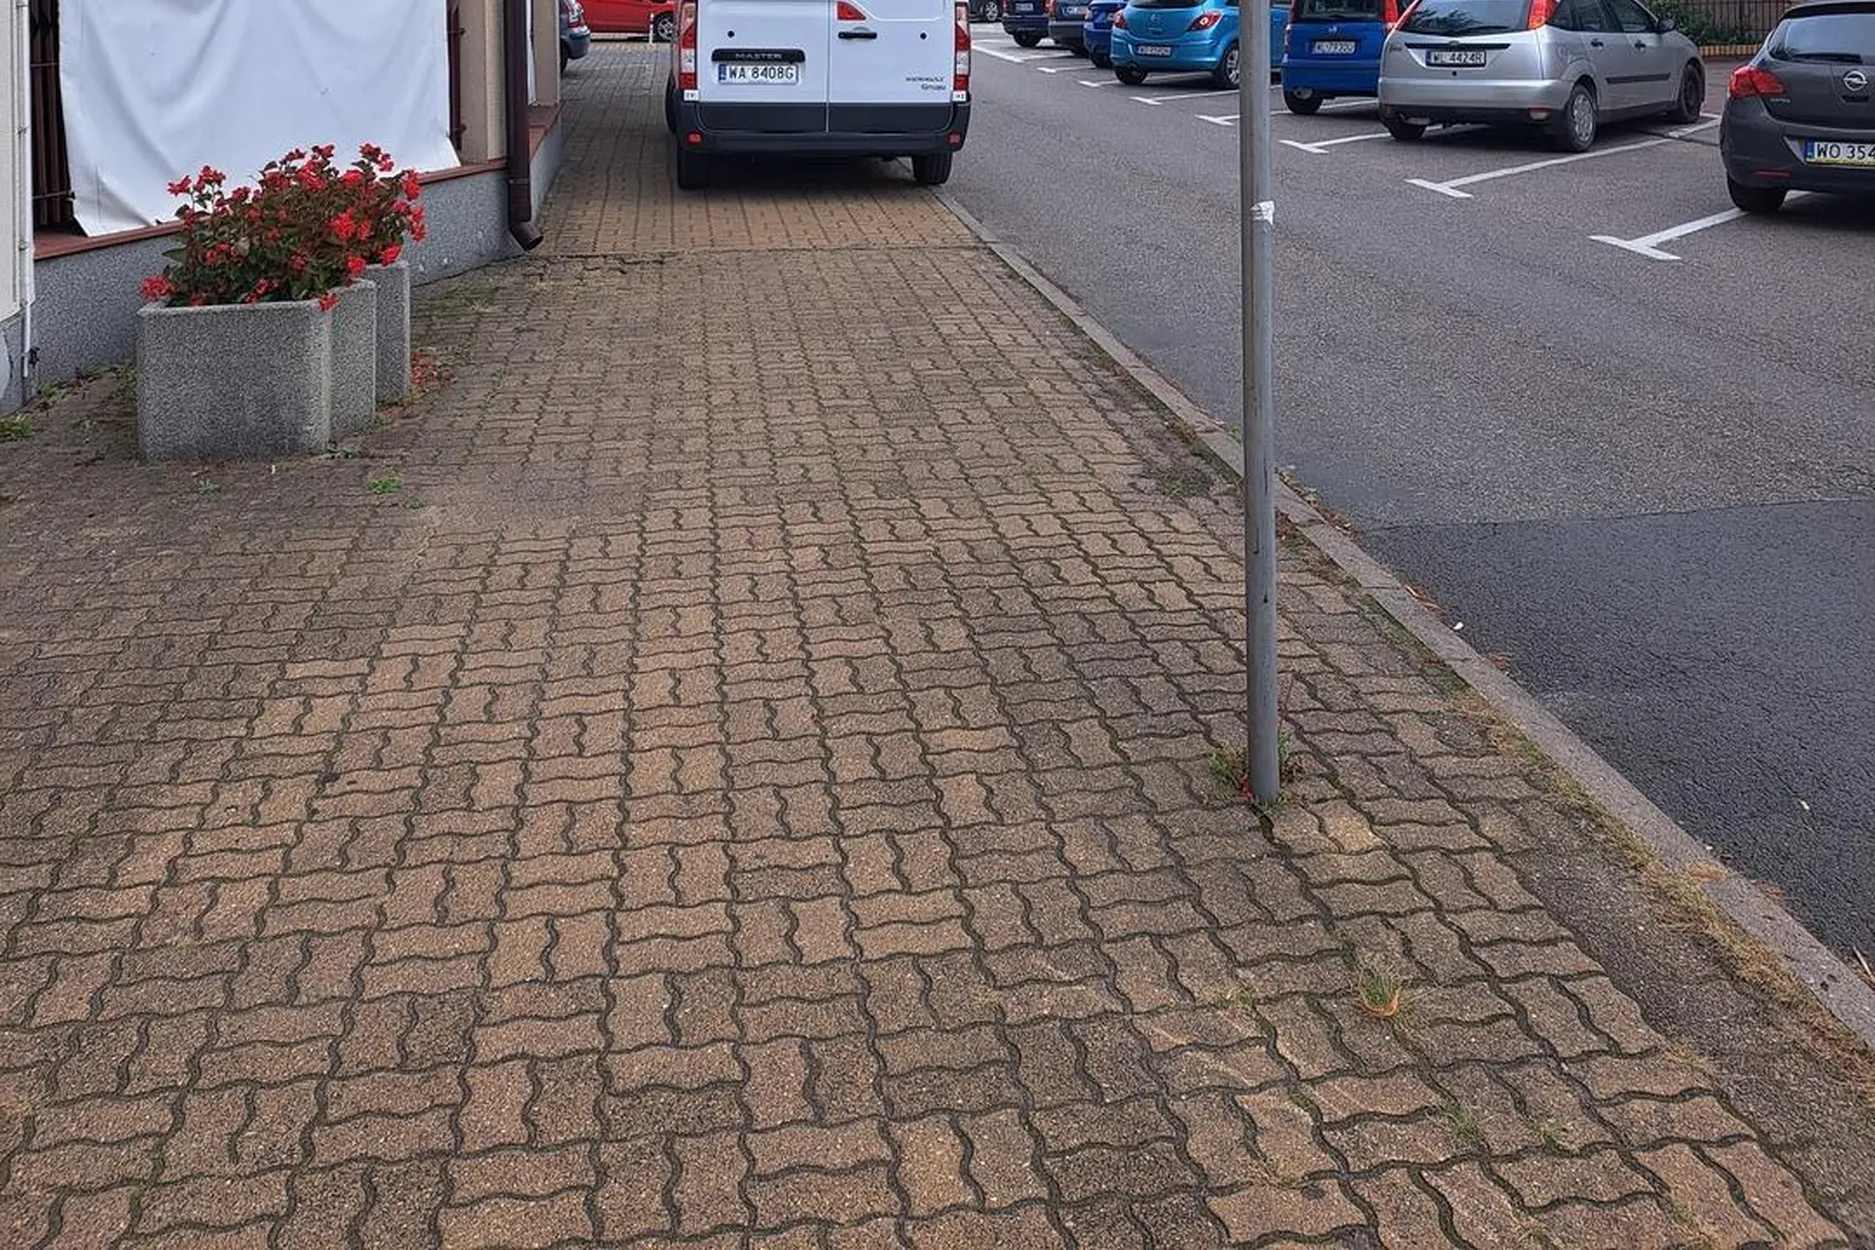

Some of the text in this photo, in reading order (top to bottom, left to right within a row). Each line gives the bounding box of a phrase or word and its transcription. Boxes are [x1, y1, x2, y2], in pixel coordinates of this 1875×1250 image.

[729, 66, 794, 80] WA 8408G
[1817, 144, 1841, 159] WO
